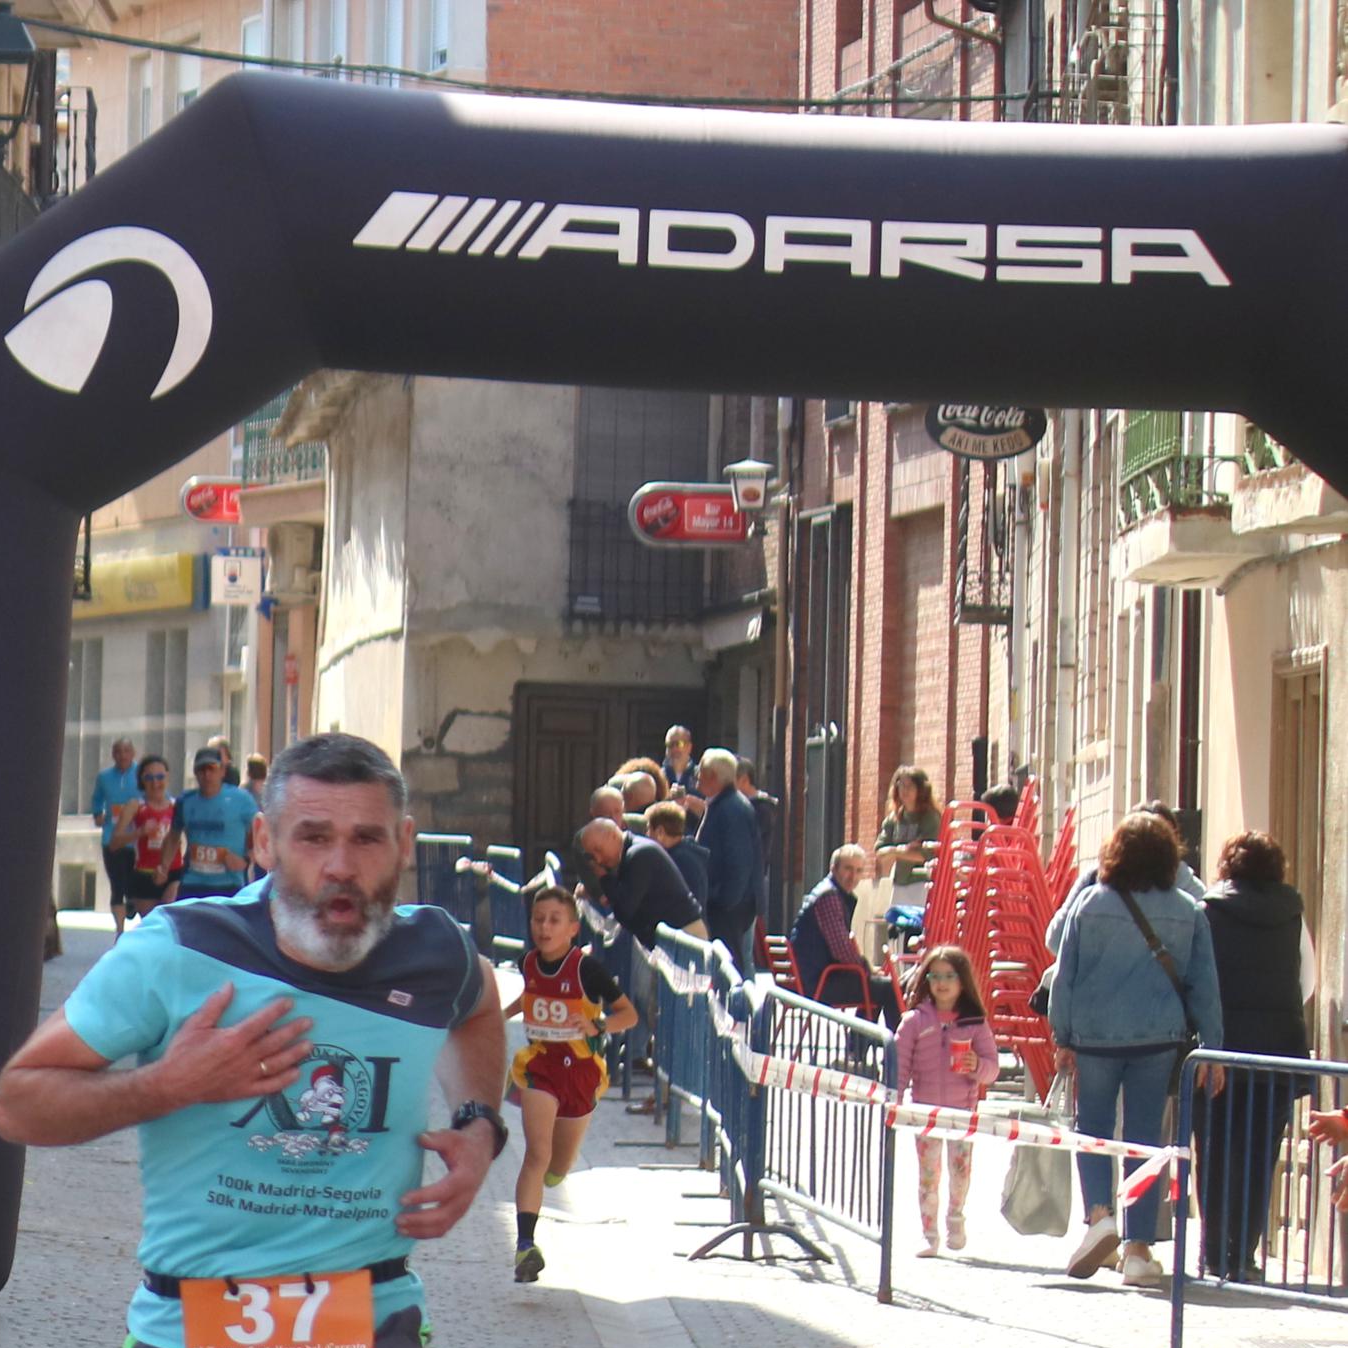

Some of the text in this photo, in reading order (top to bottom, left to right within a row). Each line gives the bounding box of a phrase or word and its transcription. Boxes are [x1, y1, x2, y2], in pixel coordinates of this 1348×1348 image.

[517, 202, 1232, 287] ADARSA
[692, 515, 720, 529] Mayor
[533, 998, 568, 1024] 69
[206, 1190, 234, 1208] 50k
[216, 1174, 382, 1204] 100k Madrid-Segovia
[223, 1281, 330, 1345] 37
